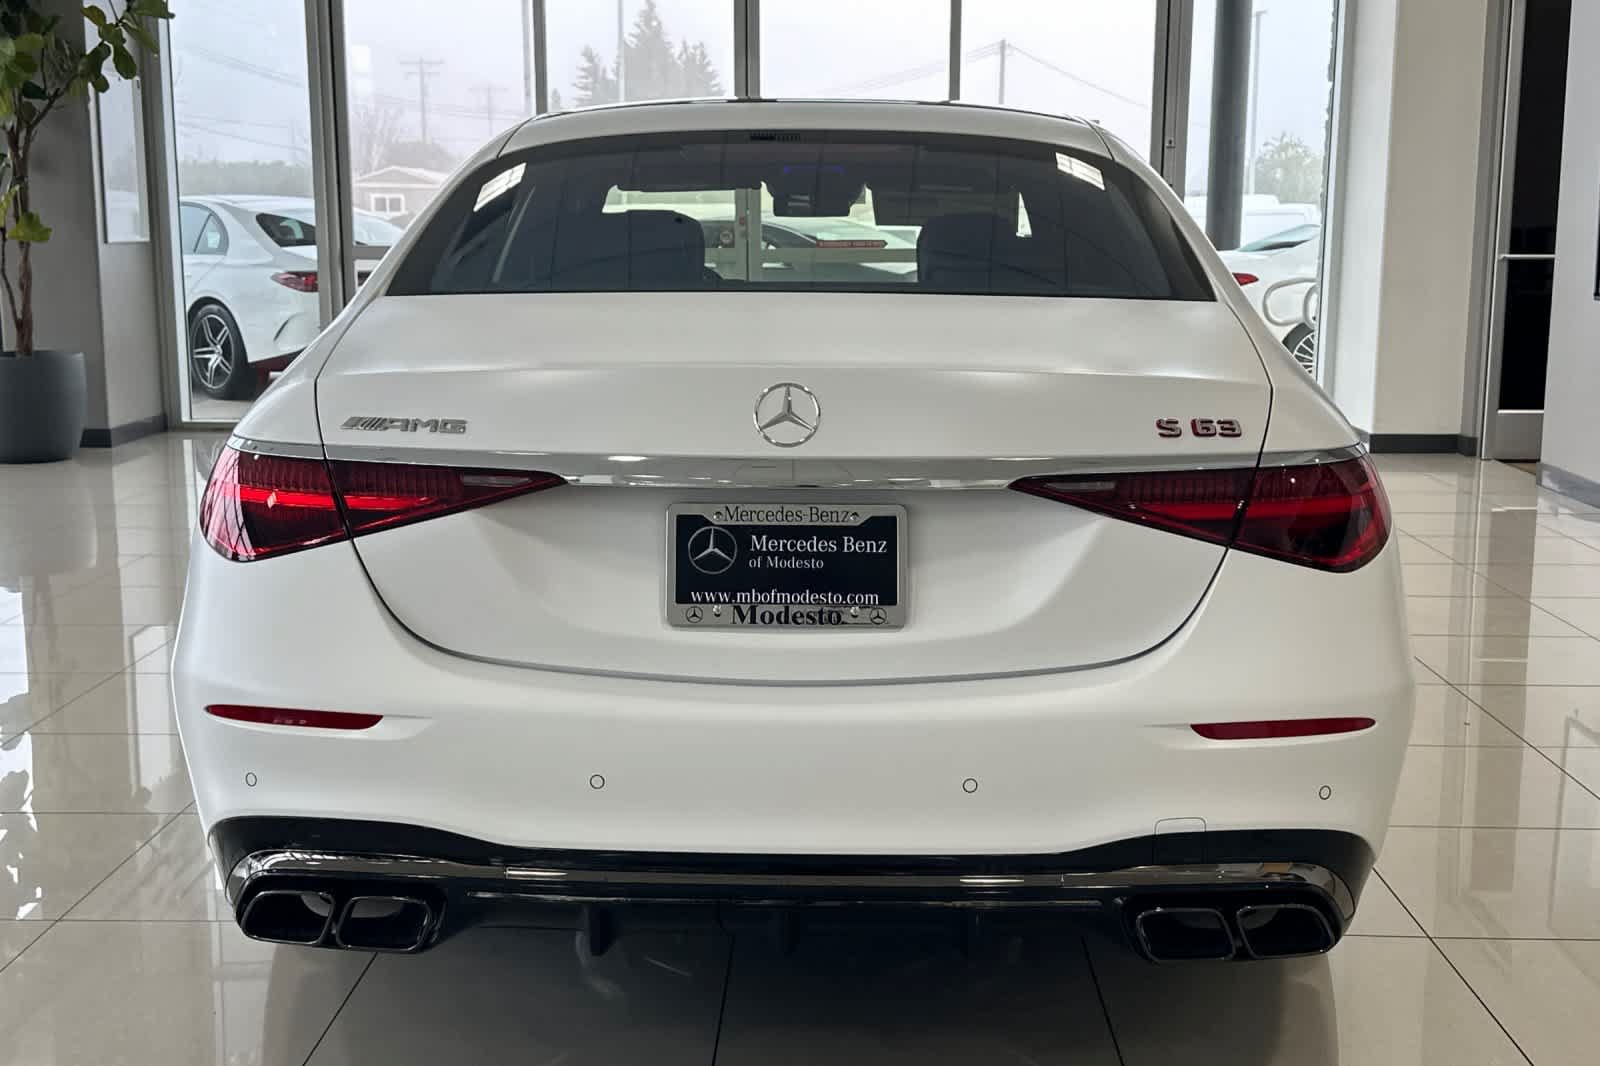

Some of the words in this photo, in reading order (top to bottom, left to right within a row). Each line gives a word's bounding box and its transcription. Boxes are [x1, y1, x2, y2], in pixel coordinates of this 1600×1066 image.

[382, 417, 467, 434] AMG
[1156, 419, 1182, 438] S
[1190, 418, 1242, 438] 63
[724, 505, 850, 523] Mercedes-Benz
[751, 535, 837, 552] Mercedes
[843, 536, 888, 553] Benz
[748, 556, 761, 568] of
[766, 556, 824, 569] Modesto
[690, 589, 879, 605] www.mbofmodesto.com
[732, 605, 842, 625] Modesto
